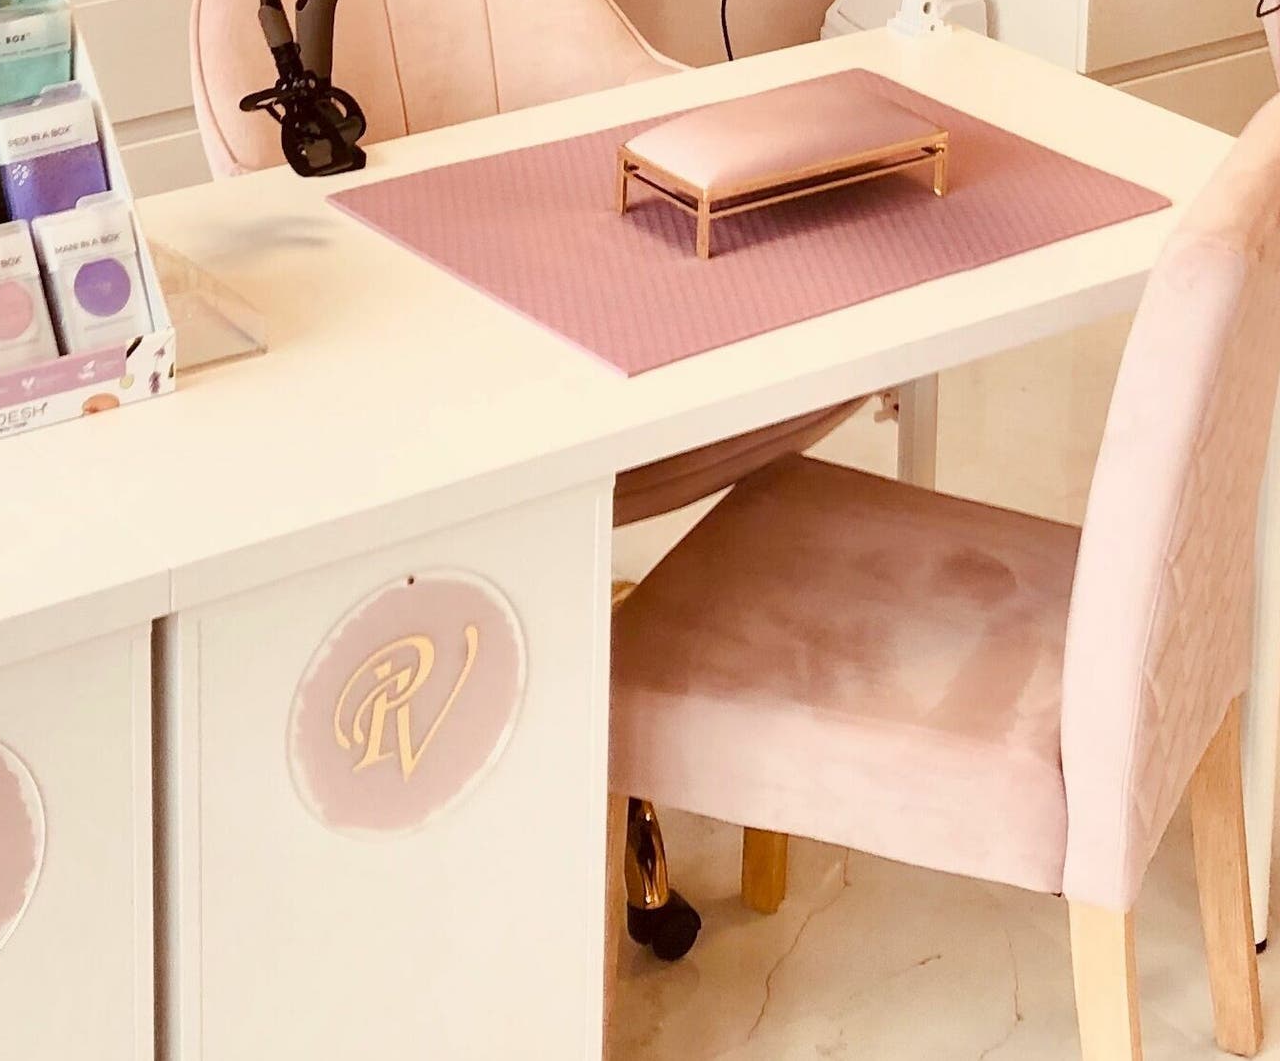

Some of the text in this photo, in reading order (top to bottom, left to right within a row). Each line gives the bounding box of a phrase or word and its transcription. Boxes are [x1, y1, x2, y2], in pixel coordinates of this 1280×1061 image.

[8, 136, 30, 147] PEDI
[31, 133, 40, 142] IN
[42, 131, 50, 139] A
